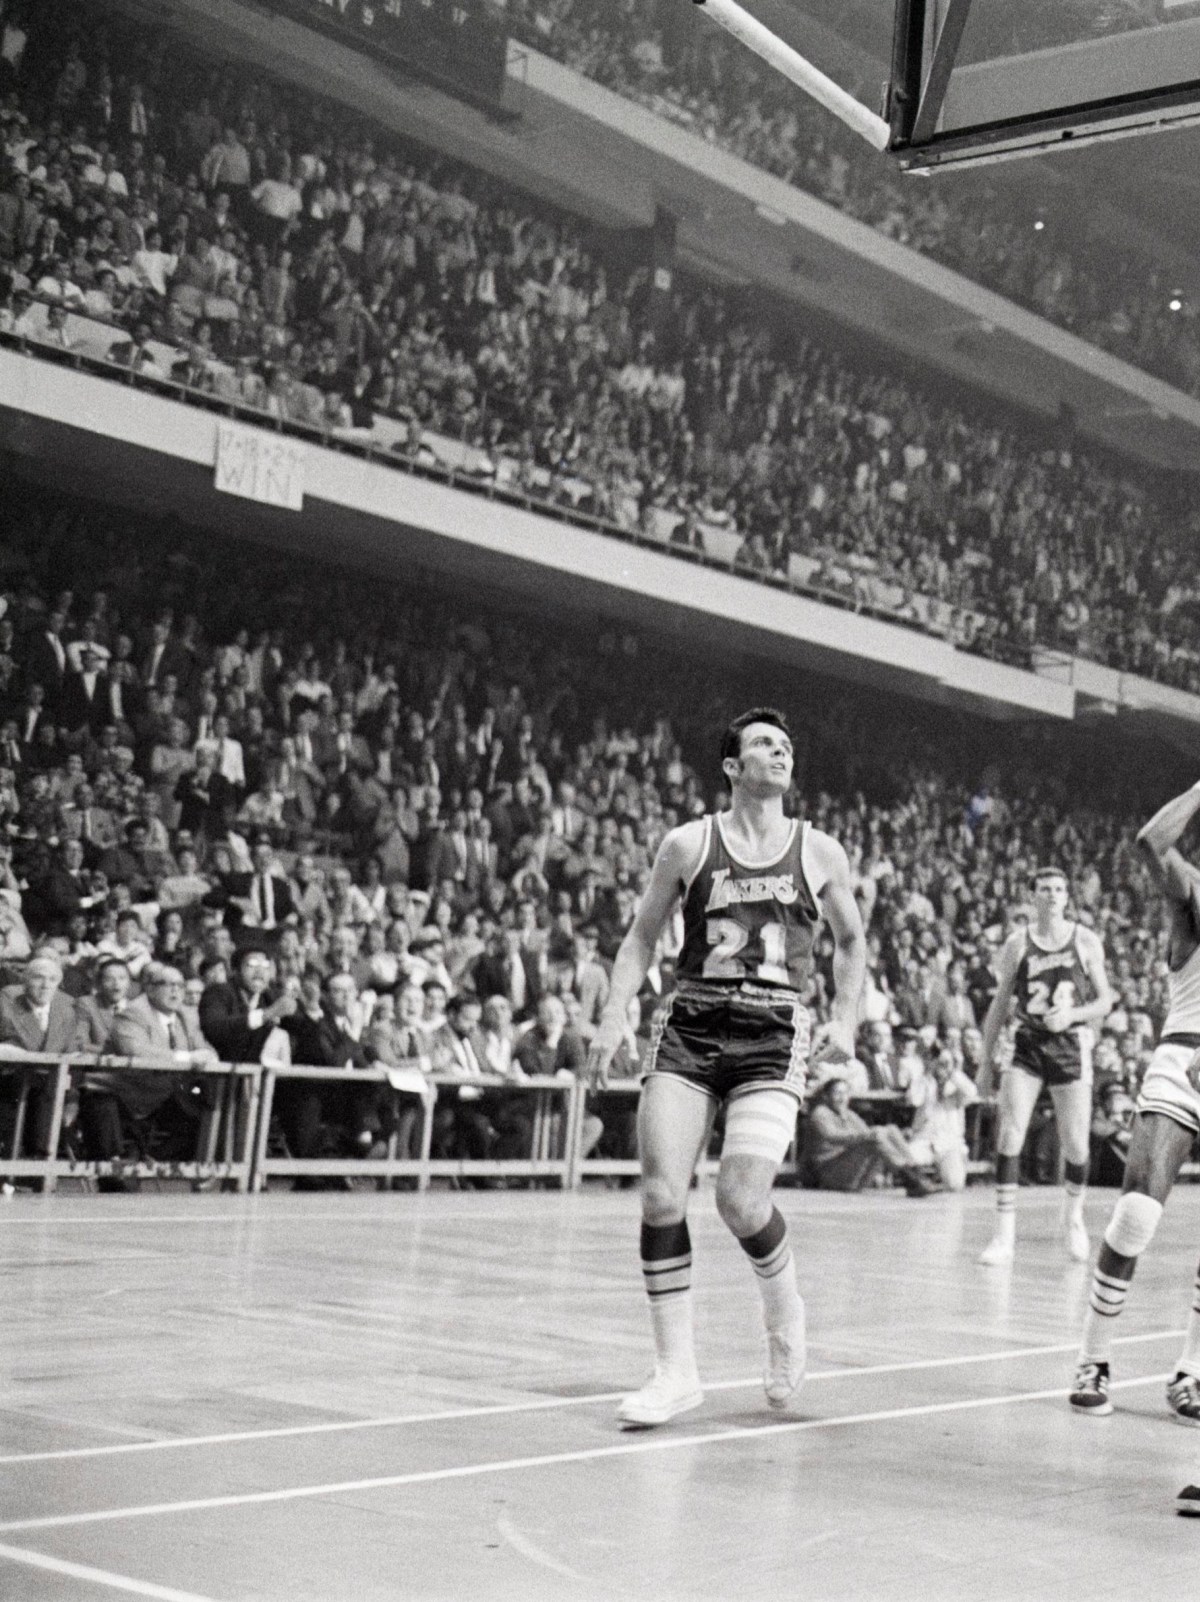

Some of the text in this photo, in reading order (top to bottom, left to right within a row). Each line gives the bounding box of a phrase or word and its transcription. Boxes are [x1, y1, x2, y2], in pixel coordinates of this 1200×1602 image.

[219, 459, 291, 502] WIN
[704, 867, 799, 913] LAKERS
[702, 917, 791, 985] 21
[1026, 980, 1075, 1015] 24
